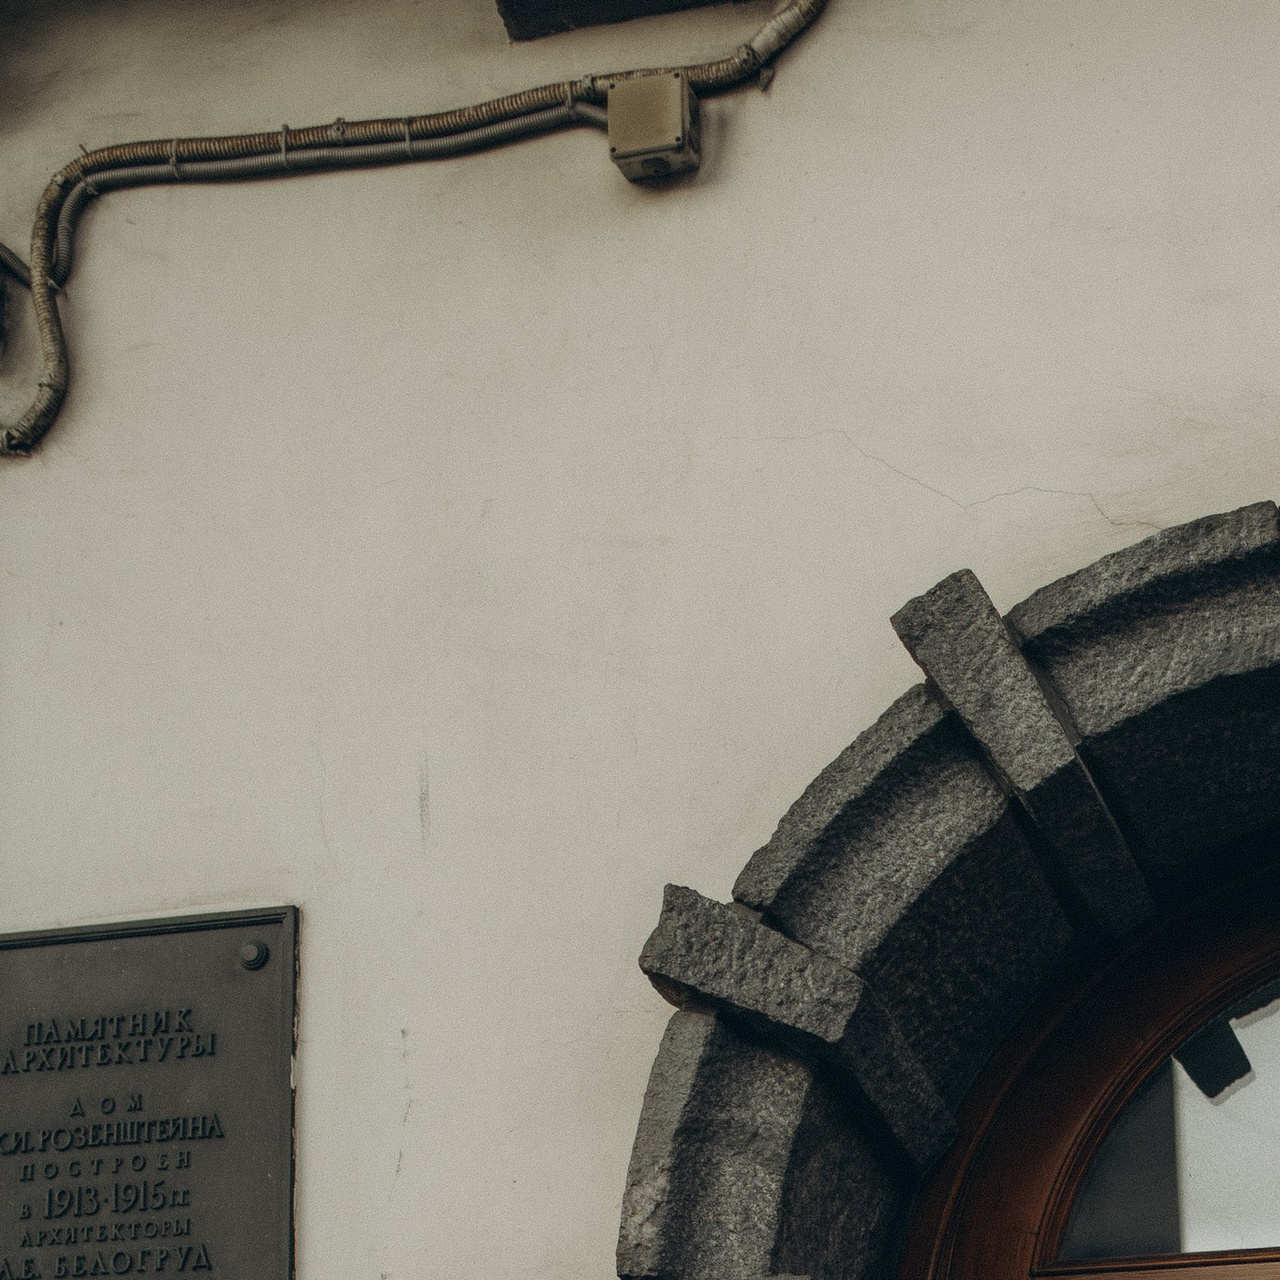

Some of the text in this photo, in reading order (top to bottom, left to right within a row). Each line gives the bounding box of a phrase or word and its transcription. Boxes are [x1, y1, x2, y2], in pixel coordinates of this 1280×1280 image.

[23, 1008, 193, 1047] ПАМЯТНИК
[1, 1033, 216, 1075] АРХИТЕКТУРЫ
[69, 1093, 144, 1118] ДОМ
[20, 1151, 191, 1182] ПОСТРОЕН
[20, 1218, 192, 1248] АРХИТЕКТОРЫ
[54, 1244, 213, 1279] БЕЛОГРУД
